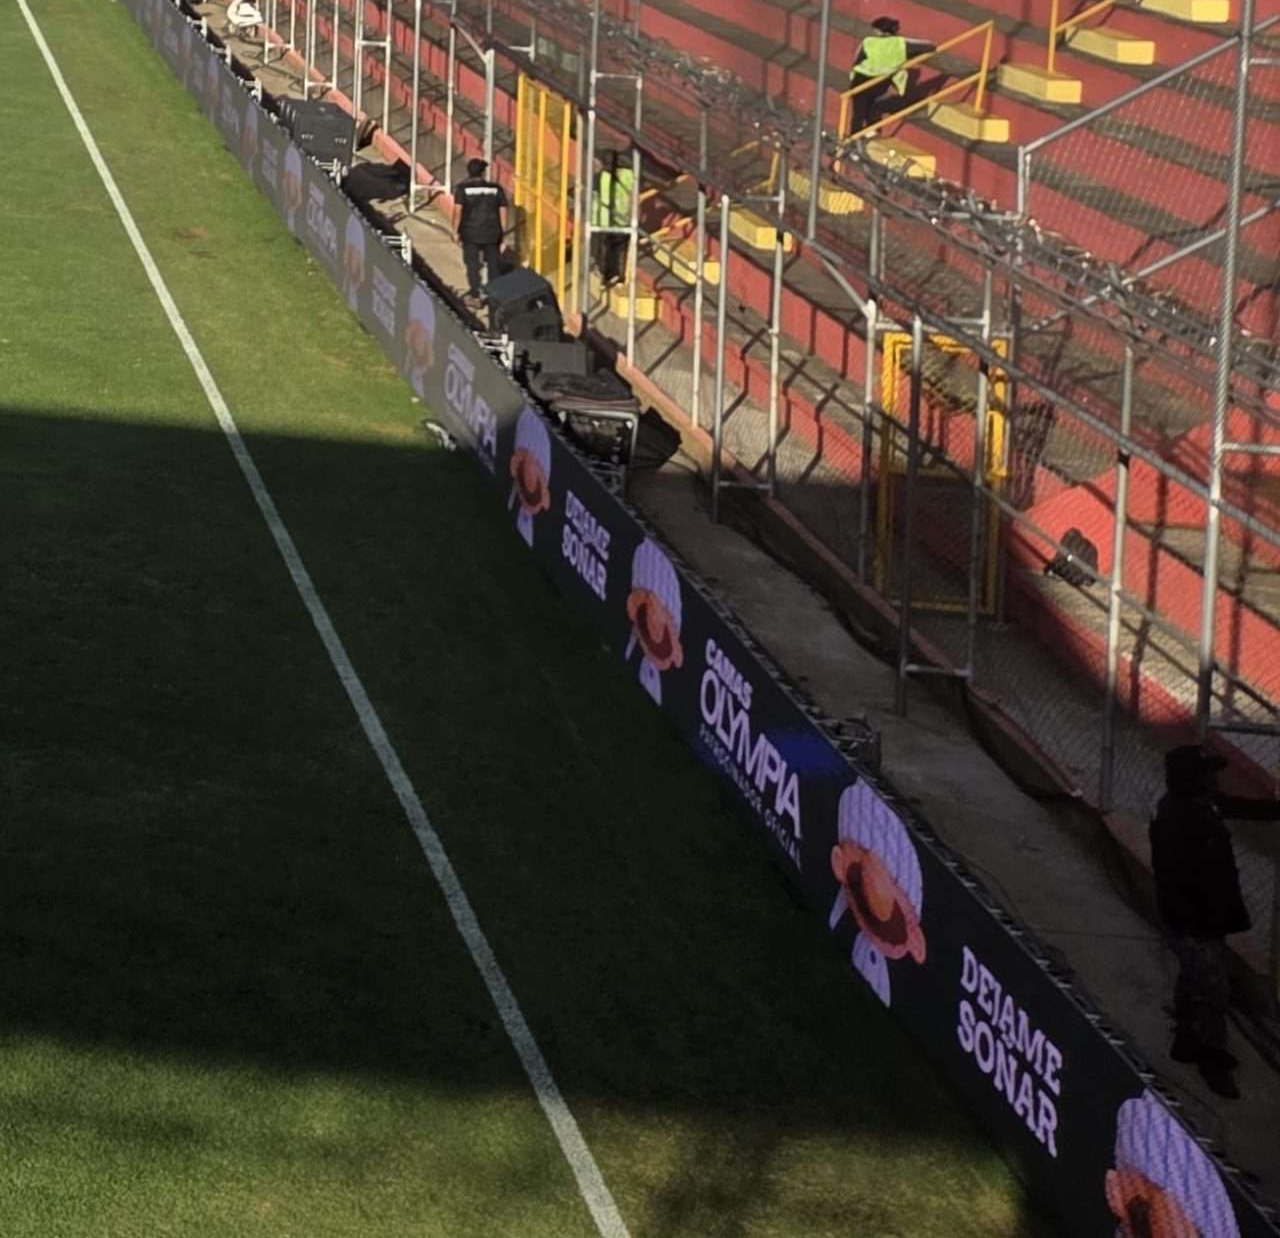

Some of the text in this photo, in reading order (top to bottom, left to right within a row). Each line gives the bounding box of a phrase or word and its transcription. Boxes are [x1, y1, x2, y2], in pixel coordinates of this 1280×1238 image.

[705, 638, 753, 711] CAMAS
[700, 668, 802, 840] OLYMPIA
[960, 945, 1063, 1097] DEJAME
